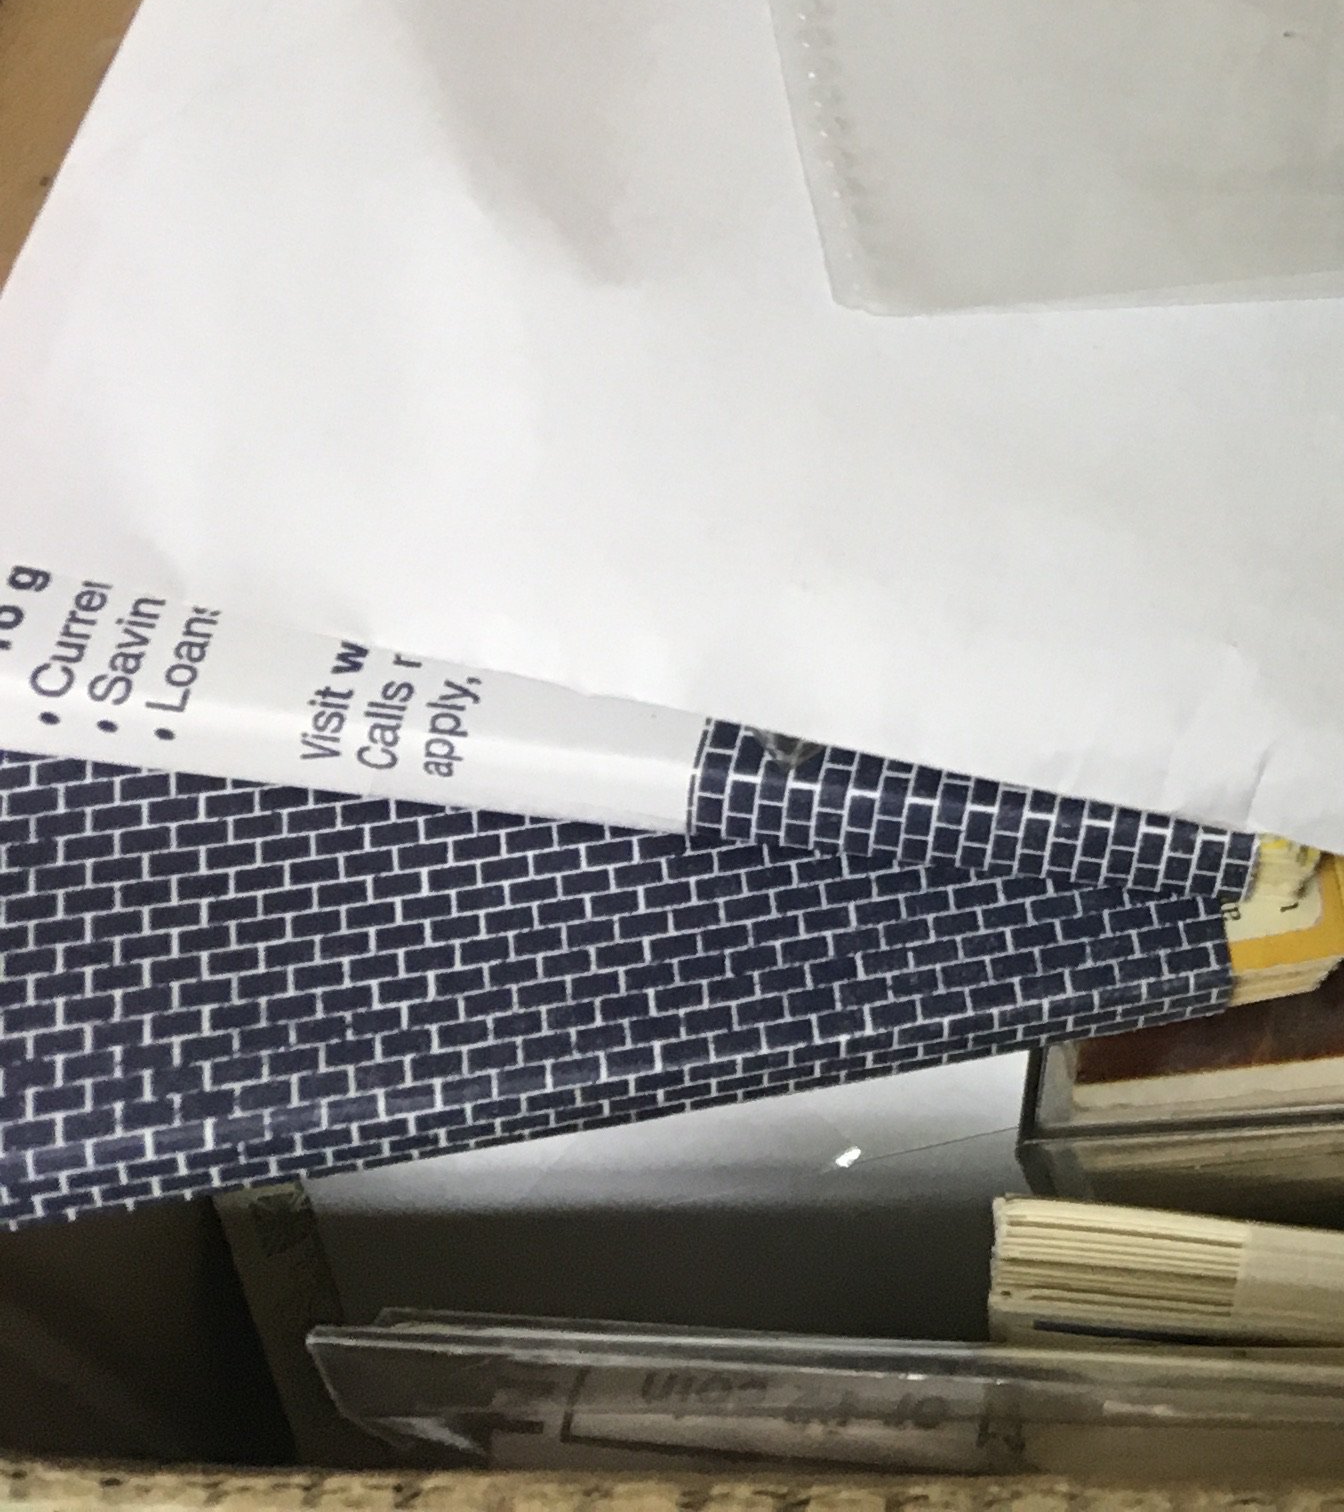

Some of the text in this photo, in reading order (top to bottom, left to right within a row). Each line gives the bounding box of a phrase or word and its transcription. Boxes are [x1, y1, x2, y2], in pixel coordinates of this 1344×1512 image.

[88, 597, 166, 705] Savin
[301, 686, 355, 762] Visit
[357, 682, 417, 771] Calls
[423, 676, 482, 779] apply,
